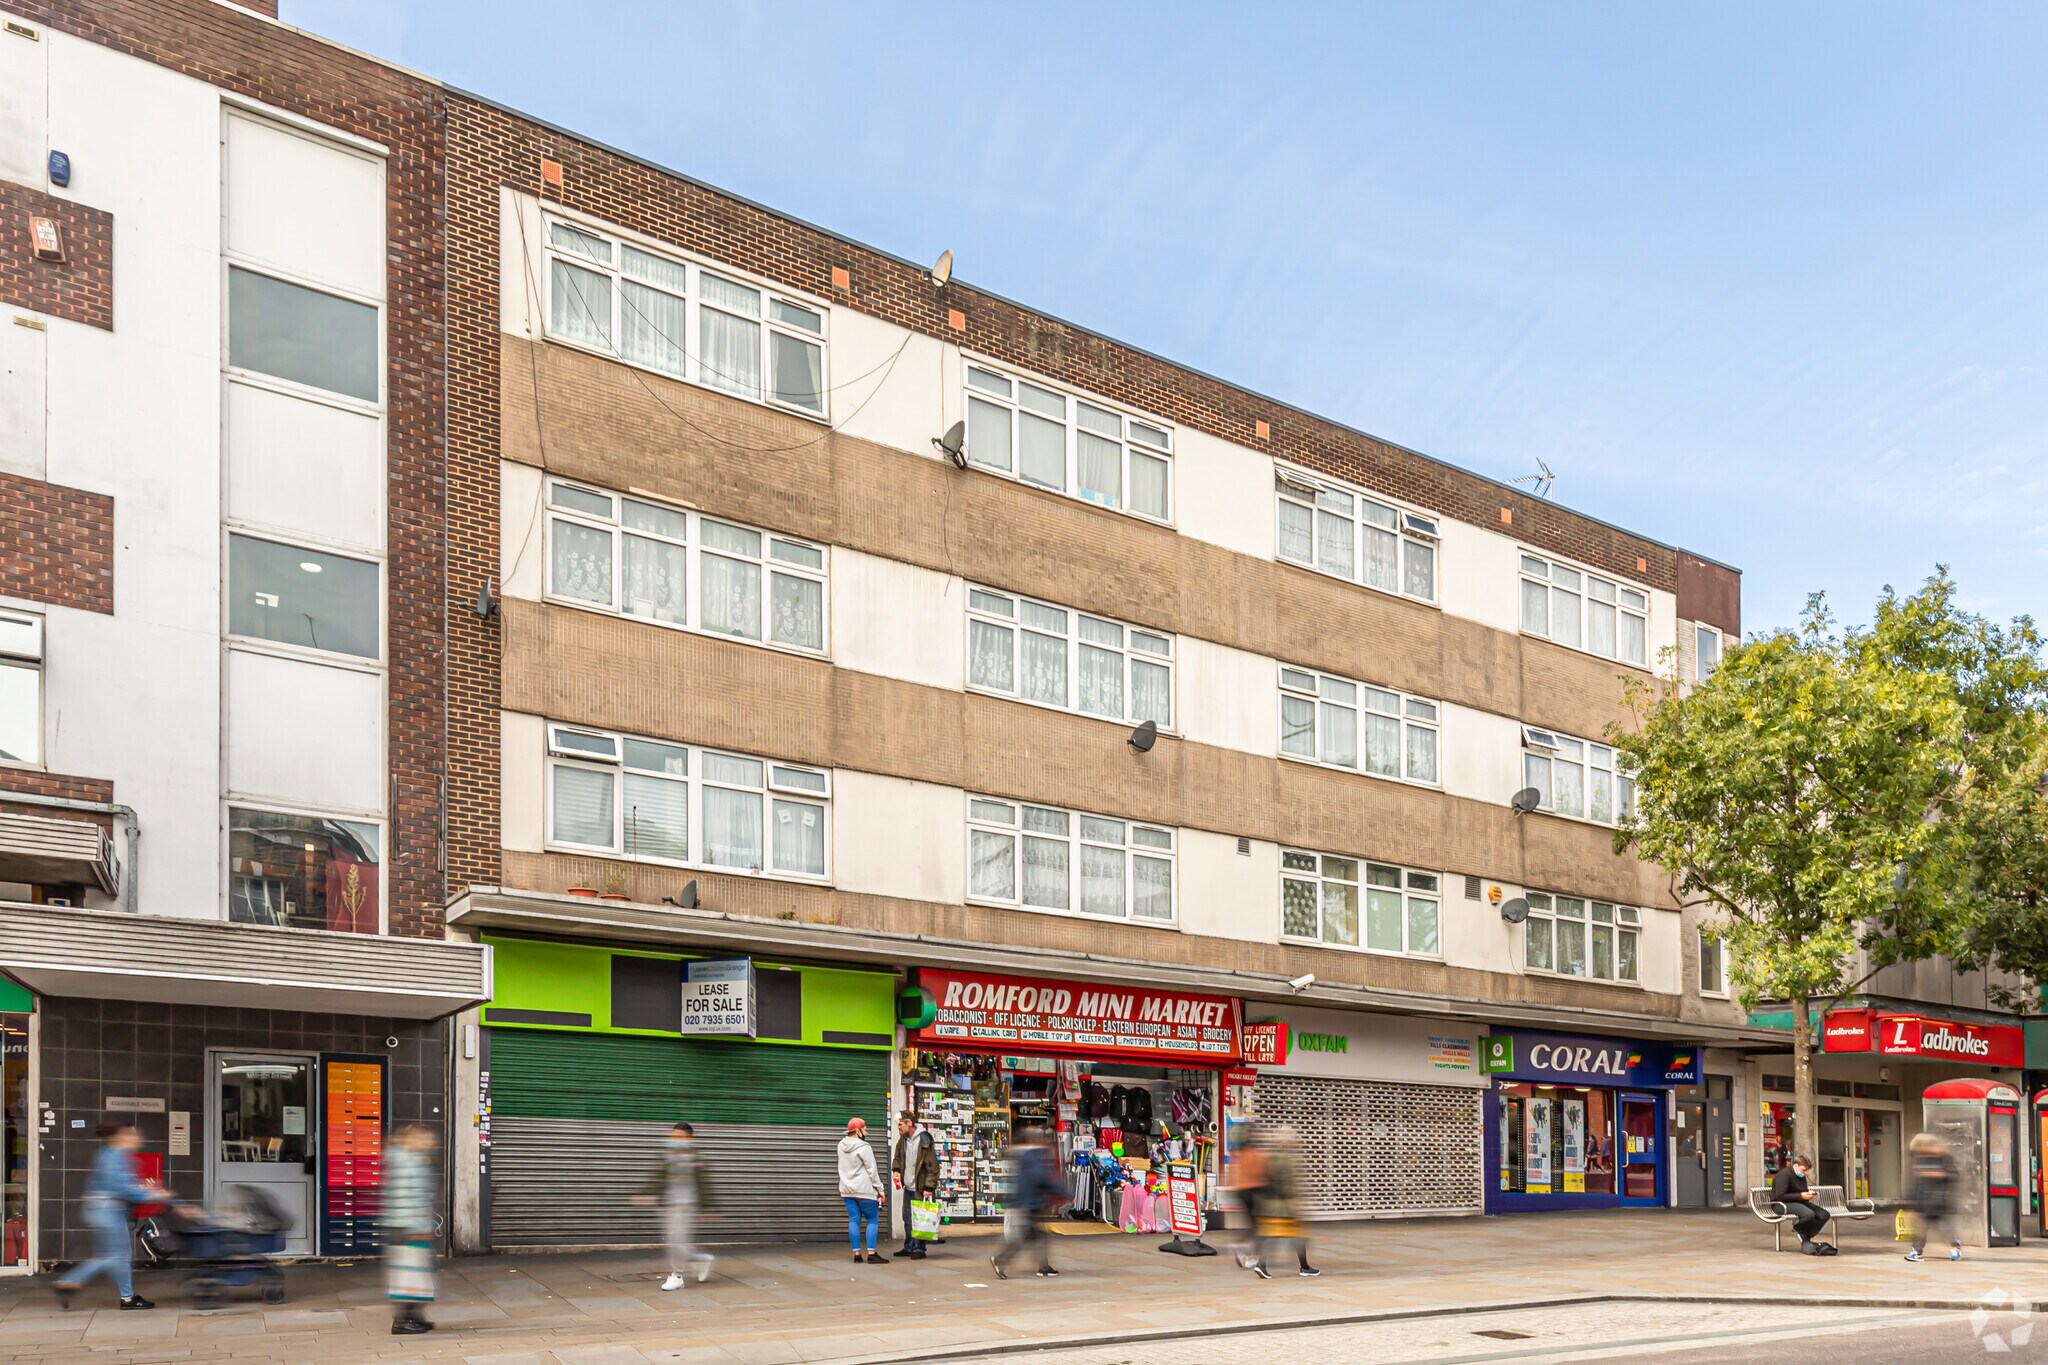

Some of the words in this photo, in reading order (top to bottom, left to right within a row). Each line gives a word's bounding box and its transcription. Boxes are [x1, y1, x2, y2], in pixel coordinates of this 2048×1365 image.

[699, 984, 729, 995] LEASE
[686, 998, 709, 1012] FOR
[713, 998, 743, 1012] SALE
[944, 981, 1071, 1014] ROMFORD
[1076, 992, 1134, 1019] MINI
[1138, 997, 1228, 1027] MARKET
[685, 1015, 700, 1025] 020
[703, 1015, 723, 1024] 7935
[725, 1015, 745, 1024] 6501
[945, 1026, 960, 1034] VAPE
[994, 1012, 1008, 1026] OFF
[1010, 1013, 1040, 1028] LICENCE
[1102, 1020, 1134, 1035] EASTERN
[1136, 1022, 1171, 1037] EUROPEAN
[1177, 1025, 1197, 1039] ASIAN
[1203, 1027, 1232, 1041] GROCERY
[1244, 1026, 1253, 1034] OFF
[1256, 1026, 1276, 1034] LICENCE
[1827, 1027, 1864, 1036] Ladbrokes
[978, 1028, 1000, 1037] CALLING
[1003, 1029, 1017, 1038] CARD
[1028, 1032, 1048, 1040] MOBILE
[1893, 1023, 1907, 1045] L
[1081, 1035, 1113, 1044] ELECTRONIC
[1123, 1037, 1155, 1046] PHOTOCOPY
[1244, 1035, 1275, 1052] OPEN
[1299, 1032, 1348, 1054] OXFAM
[1921, 1027, 1989, 1056] adbrokes
[1164, 1041, 1197, 1049] HOUSEHOLDS
[1244, 1052, 1256, 1061] TILL
[1258, 1053, 1274, 1062] LATE
[1530, 1044, 1626, 1075] CORAL
[1665, 1072, 1694, 1080] CORAL
